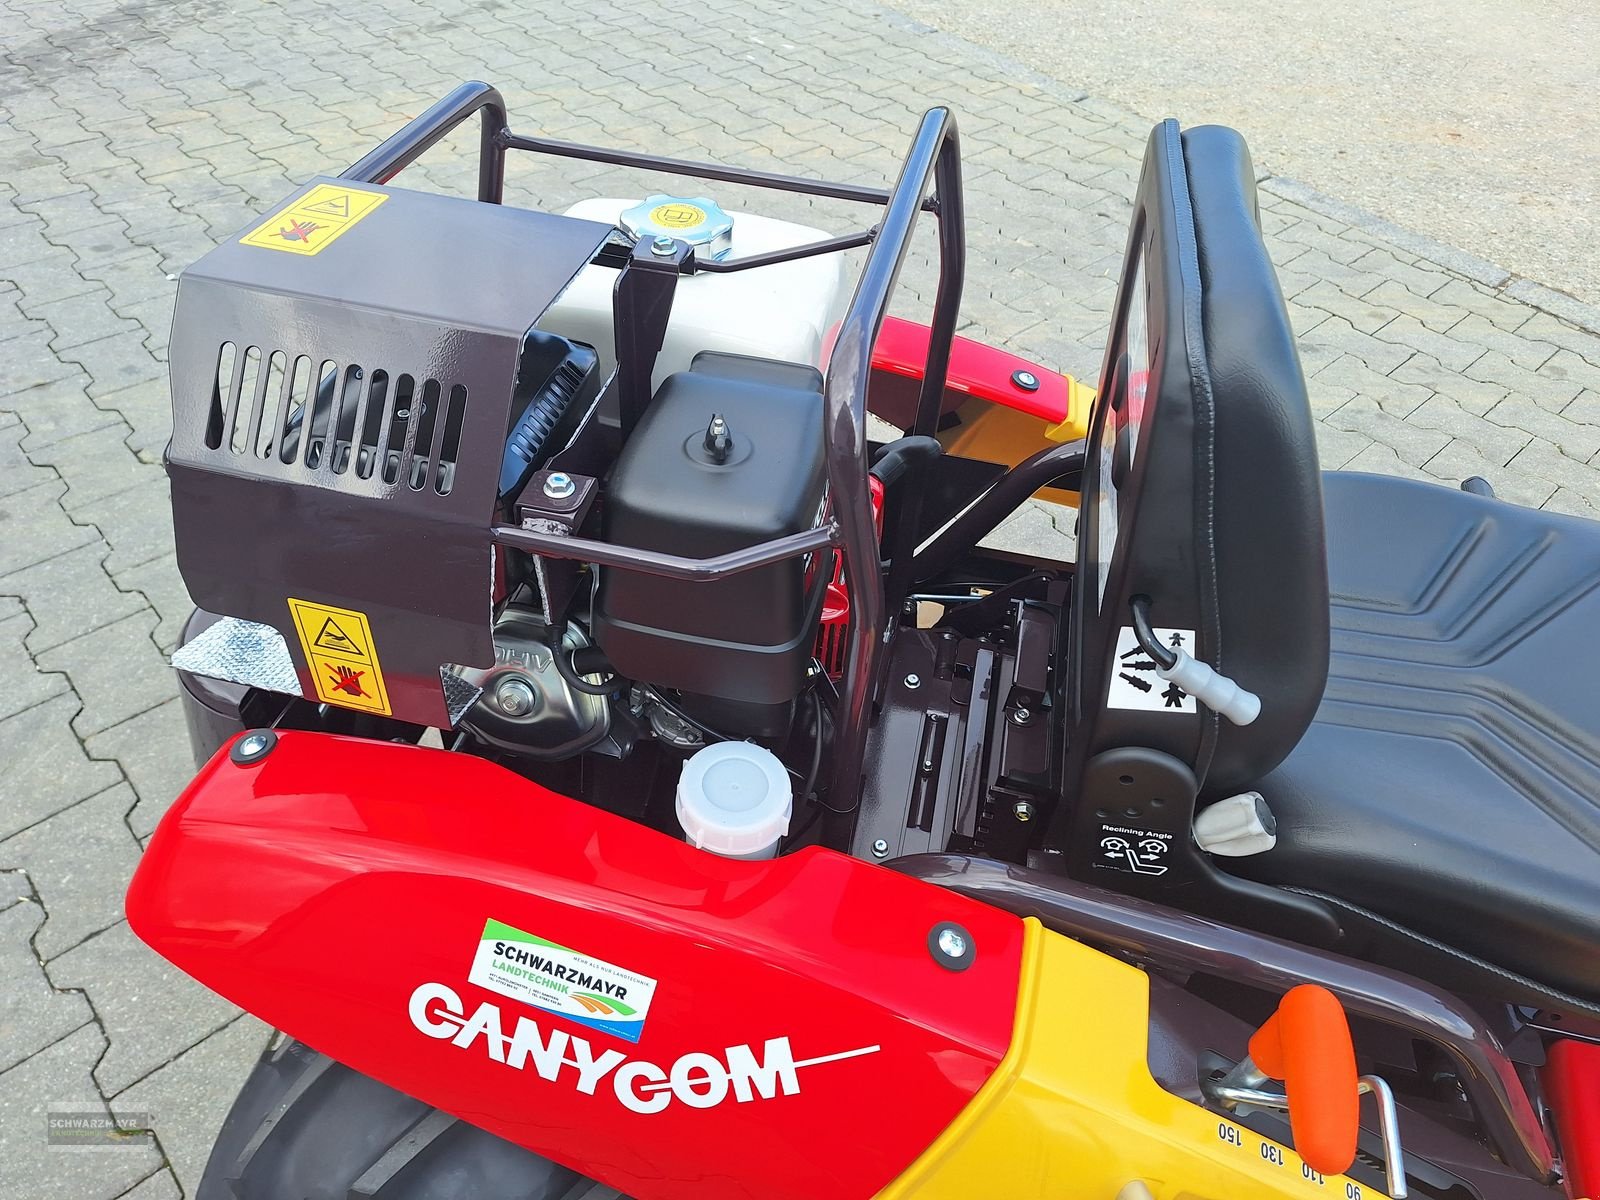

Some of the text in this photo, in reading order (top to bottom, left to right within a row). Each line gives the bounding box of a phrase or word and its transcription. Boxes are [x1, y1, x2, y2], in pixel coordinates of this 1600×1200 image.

[1102, 824, 1173, 840] Reclining Angle
[493, 941, 628, 1001] SCHWARZMAYR
[573, 956, 588, 965] MEHR
[492, 958, 571, 995] LANDTECHNIK
[408, 982, 801, 1114] CANYCOM
[1218, 1123, 1242, 1147] 150
[1260, 1142, 1284, 1166] 130
[1302, 1161, 1324, 1185] 110
[1346, 1182, 1361, 1200] 90
